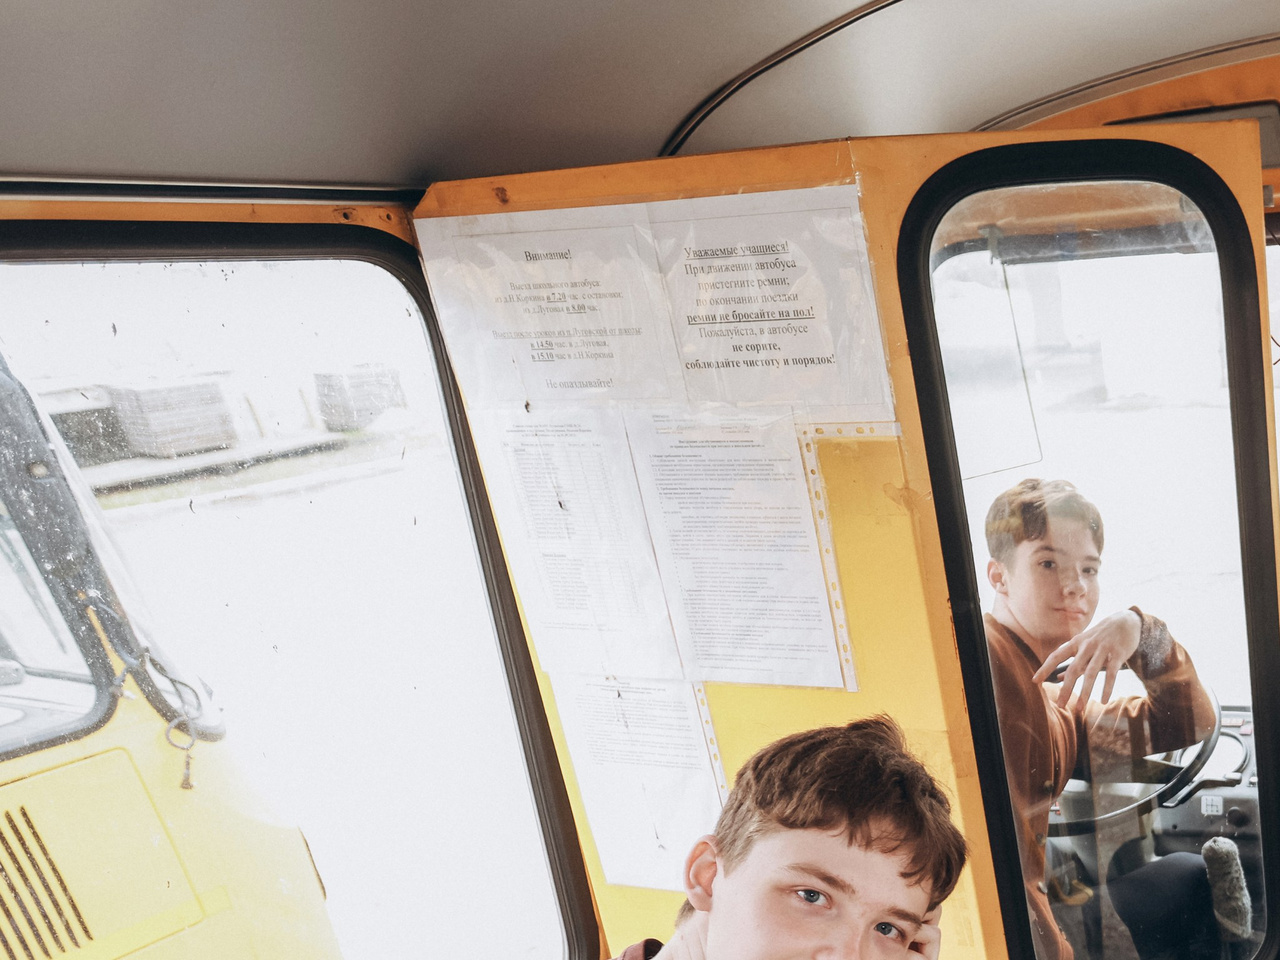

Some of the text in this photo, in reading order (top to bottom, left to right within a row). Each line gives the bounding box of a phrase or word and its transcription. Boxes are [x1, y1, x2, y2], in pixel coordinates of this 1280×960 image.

[524, 249, 573, 262] Внимание!
[684, 241, 789, 259] Уважаемые учащиеся!
[684, 258, 796, 276] При движении автобуса
[698, 280, 755, 292] пристегните
[551, 292, 567, 300] 7.20
[696, 293, 798, 306] по окончании поездки
[571, 303, 586, 311] 8.00
[687, 306, 815, 324] ремни не бросайте на пол!
[698, 326, 758, 339] Пожалуйста,
[767, 323, 808, 337] автобусе
[536, 340, 553, 348] 14.50
[732, 342, 781, 354] не сорите,
[536, 352, 554, 360] 15.10
[685, 354, 836, 370] соблюдайте чистоту и порядок!
[546, 377, 614, 390] Не опаздывайте!
